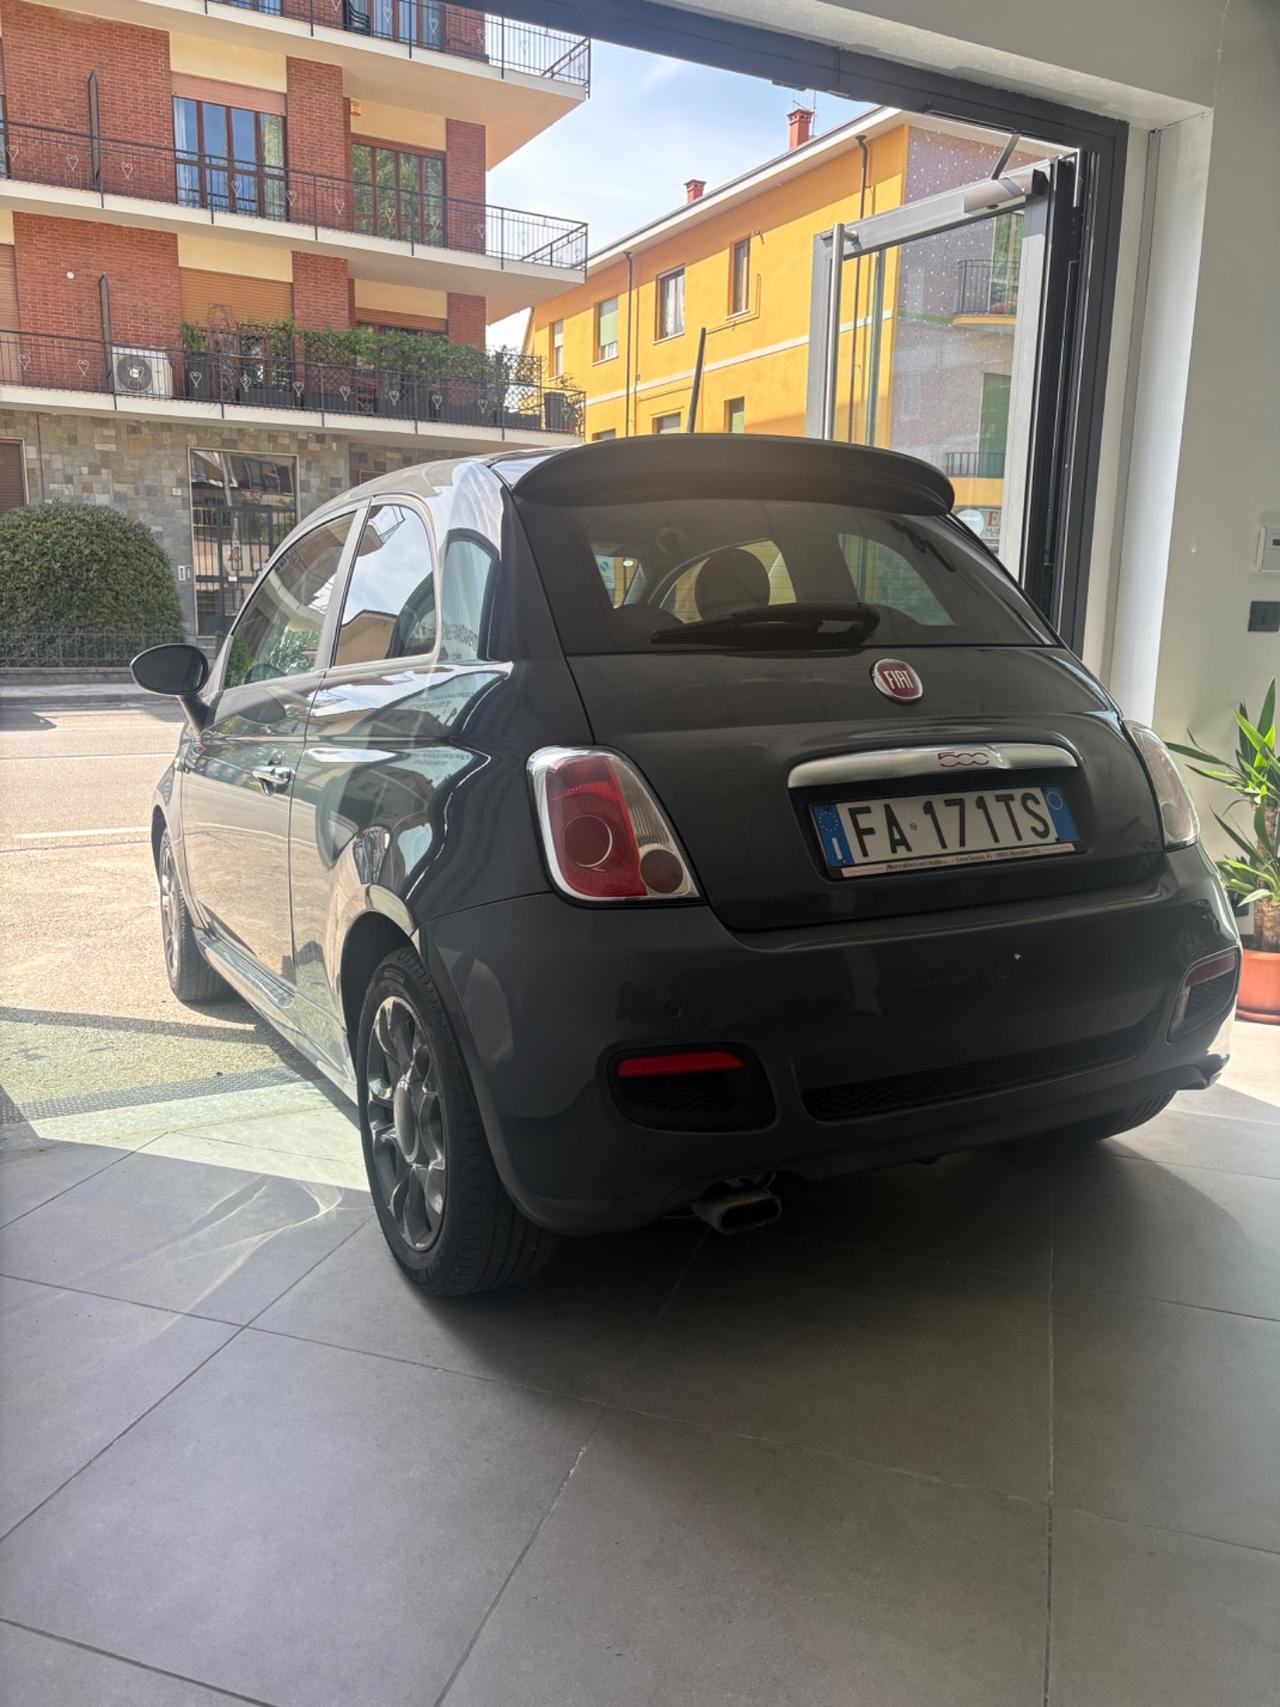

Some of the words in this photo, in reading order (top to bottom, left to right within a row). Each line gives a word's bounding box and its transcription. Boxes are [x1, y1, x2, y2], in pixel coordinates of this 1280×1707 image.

[883, 670, 914, 690] FIAT
[937, 751, 989, 768] 500
[848, 803, 912, 857] FA
[922, 792, 1051, 849] 171TS
